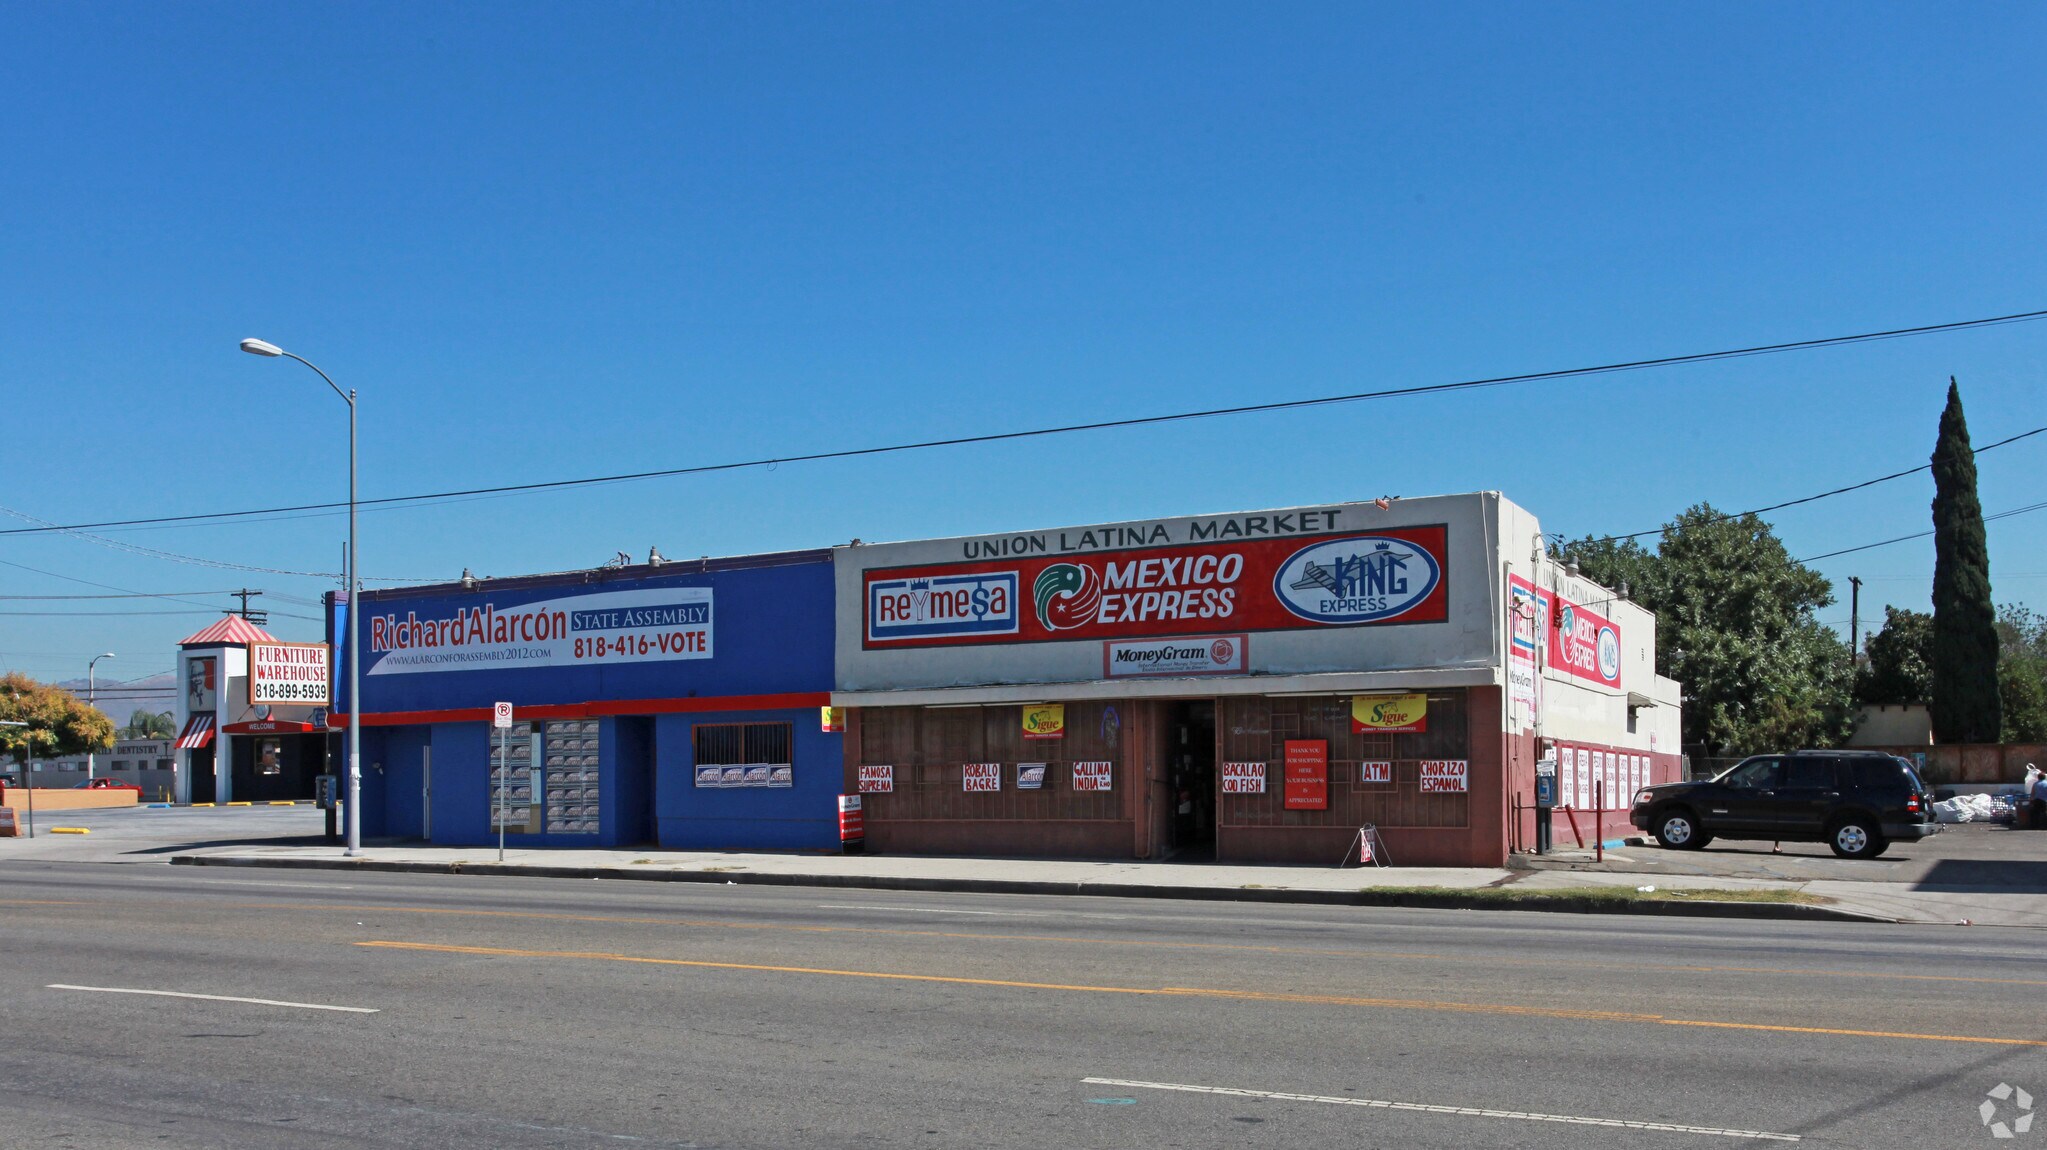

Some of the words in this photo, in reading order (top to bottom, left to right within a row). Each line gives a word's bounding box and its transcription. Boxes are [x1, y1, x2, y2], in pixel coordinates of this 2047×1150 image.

[964, 534, 1046, 559] UNION
[1060, 523, 1170, 551] LATINA
[1189, 509, 1342, 541] MARKET
[1103, 553, 1244, 590] MEXICO
[1334, 553, 1408, 598] KING
[1543, 568, 1565, 594] UNON
[1566, 581, 1588, 606] LATINA
[1589, 594, 1612, 618] MARKT
[1097, 587, 1236, 624] EXPRESS
[1319, 597, 1388, 613] EXPRESS
[1575, 615, 1595, 644] MEXICO
[573, 631, 706, 659] 818-416-VOTE
[258, 646, 324, 665] FURNITURE
[1115, 645, 1206, 664] MoneyGram
[256, 664, 327, 682] WAREHOUSE
[255, 683, 327, 699] 818-899-5939
[1027, 712, 1059, 733] Sigue
[1371, 703, 1409, 726] Sigue
[249, 722, 276, 731] WELCOME
[117, 745, 158, 755] DENTISTRY
[860, 766, 891, 779] FAMOSA
[964, 763, 998, 778] ROBALO
[1223, 763, 1264, 777] BACALAO
[1363, 763, 1389, 780] ATM
[1420, 761, 1465, 776] CHORIZO
[965, 778, 998, 791] BAGRE
[1074, 776, 1099, 790] INDIA
[1223, 778, 1238, 792] COD
[1240, 778, 1262, 792] FISH
